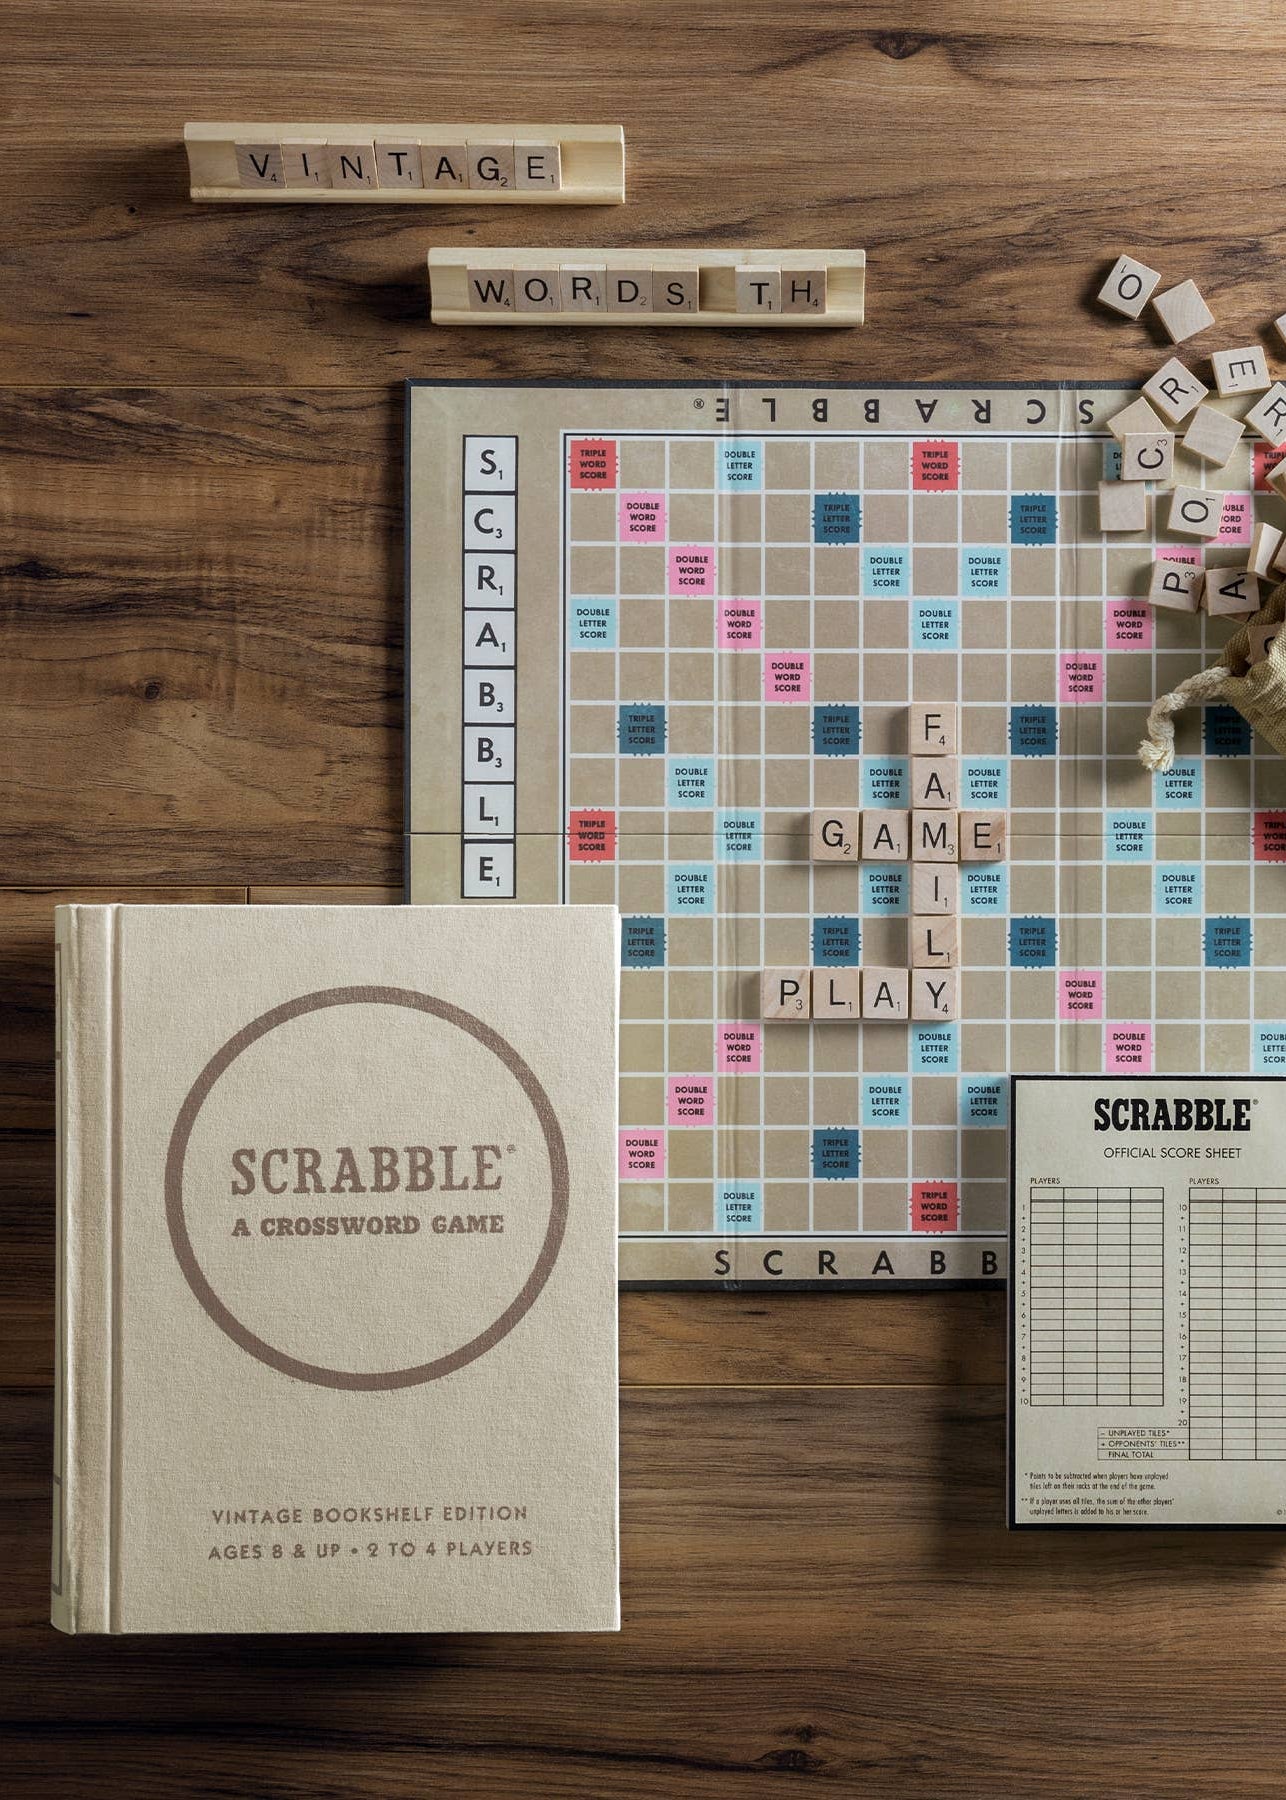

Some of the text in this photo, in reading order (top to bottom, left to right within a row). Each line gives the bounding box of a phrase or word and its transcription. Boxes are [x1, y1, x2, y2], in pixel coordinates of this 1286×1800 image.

[580, 449, 607, 457] TRIPLE
[921, 450, 949, 459] TRIPLE
[579, 460, 607, 469] WORD
[921, 461, 949, 470] WORD
[579, 471, 607, 480] SCORE
[921, 472, 949, 481] SCORE
[626, 502, 660, 511] DOUBLE
[629, 513, 656, 521] WORD
[629, 524, 656, 533] SCORE
[675, 555, 709, 564] DOUBLE
[869, 556, 903, 565] DOUBLE
[968, 557, 1002, 565] DOUBLE
[678, 566, 705, 575] WORD
[872, 567, 901, 576] LETTER
[970, 568, 999, 576] LETTER
[678, 577, 706, 586] SCORE
[873, 579, 900, 587] SCORE
[971, 579, 999, 588] SCORE
[576, 608, 610, 617] DOUBLE
[724, 609, 755, 618] DOUBLE
[919, 609, 952, 618] DOUBLE
[1113, 608, 1147, 618] DOUBLE
[579, 619, 607, 628] LETTER
[727, 620, 752, 629] WORD
[921, 620, 949, 629] LETTER
[1116, 620, 1143, 629] WORD
[579, 630, 607, 639] SCORE
[726, 631, 752, 640] SCORE
[921, 632, 949, 640] SCORE
[1116, 631, 1143, 640] SCORE
[771, 662, 804, 670] DOUBLE
[774, 673, 801, 681] WORD
[774, 684, 801, 692] SCORE
[675, 767, 708, 776] DOUBLE
[968, 768, 1001, 777] DOUBLE
[1162, 768, 1196, 777] DOUBLE
[677, 779, 705, 787] LETTER
[970, 780, 998, 788] LETTER
[1164, 779, 1193, 788] LETTER
[678, 790, 705, 799] SCORE
[970, 791, 998, 799] SCORE
[1165, 791, 1193, 799] SCORE
[1113, 821, 1146, 830] DOUBLE
[1115, 832, 1144, 841] LETTER
[1115, 843, 1143, 852] SCORE
[869, 874, 903, 883] DOUBLE
[1162, 874, 1196, 882] DOUBLE
[871, 885, 900, 894] LETTER
[1164, 885, 1193, 894] LETTER
[872, 896, 900, 905] SCORE
[1165, 896, 1193, 905] SCORE
[1065, 980, 1097, 988] DOUBLE
[1067, 991, 1094, 999] WORD
[1067, 1001, 1094, 1010] SCORE
[918, 1033, 952, 1041] DOUBLE
[1112, 1032, 1146, 1041] DOUBLE
[920, 1044, 949, 1053] LETTER
[1115, 1043, 1142, 1052] WORD
[921, 1055, 949, 1064] SCORE
[1115, 1054, 1143, 1063] SCORE
[675, 1086, 708, 1094] DOUBLE
[869, 1086, 902, 1094] DOUBLE
[677, 1097, 705, 1105] WORD
[871, 1097, 900, 1105] LETTER
[677, 1107, 705, 1116] SCORE
[871, 1108, 900, 1117] SCORE
[625, 1139, 659, 1147] DOUBLE
[628, 1150, 656, 1158] WORD
[1103, 1147, 1242, 1159] OFFICIAL SCORE SHEET
[628, 1161, 656, 1169] SCORE
[1030, 1177, 1061, 1185] PLAYERS
[1189, 1177, 1220, 1185] PLAYERS
[921, 1191, 948, 1200] TRIPLE
[920, 1202, 948, 1211] WORD
[920, 1213, 949, 1222] SCORE
[231, 1214, 504, 1237] A CROSSWORD GAME
[1108, 1429, 1146, 1437] UNPLAYED
[1108, 1450, 1154, 1459] FINAL TOTAL
[212, 1506, 527, 1525] VINTAGE BOOKSHELF EDITION
[209, 1541, 531, 1560] AGES 8 & UP 2 TO 4 PLAYERS
